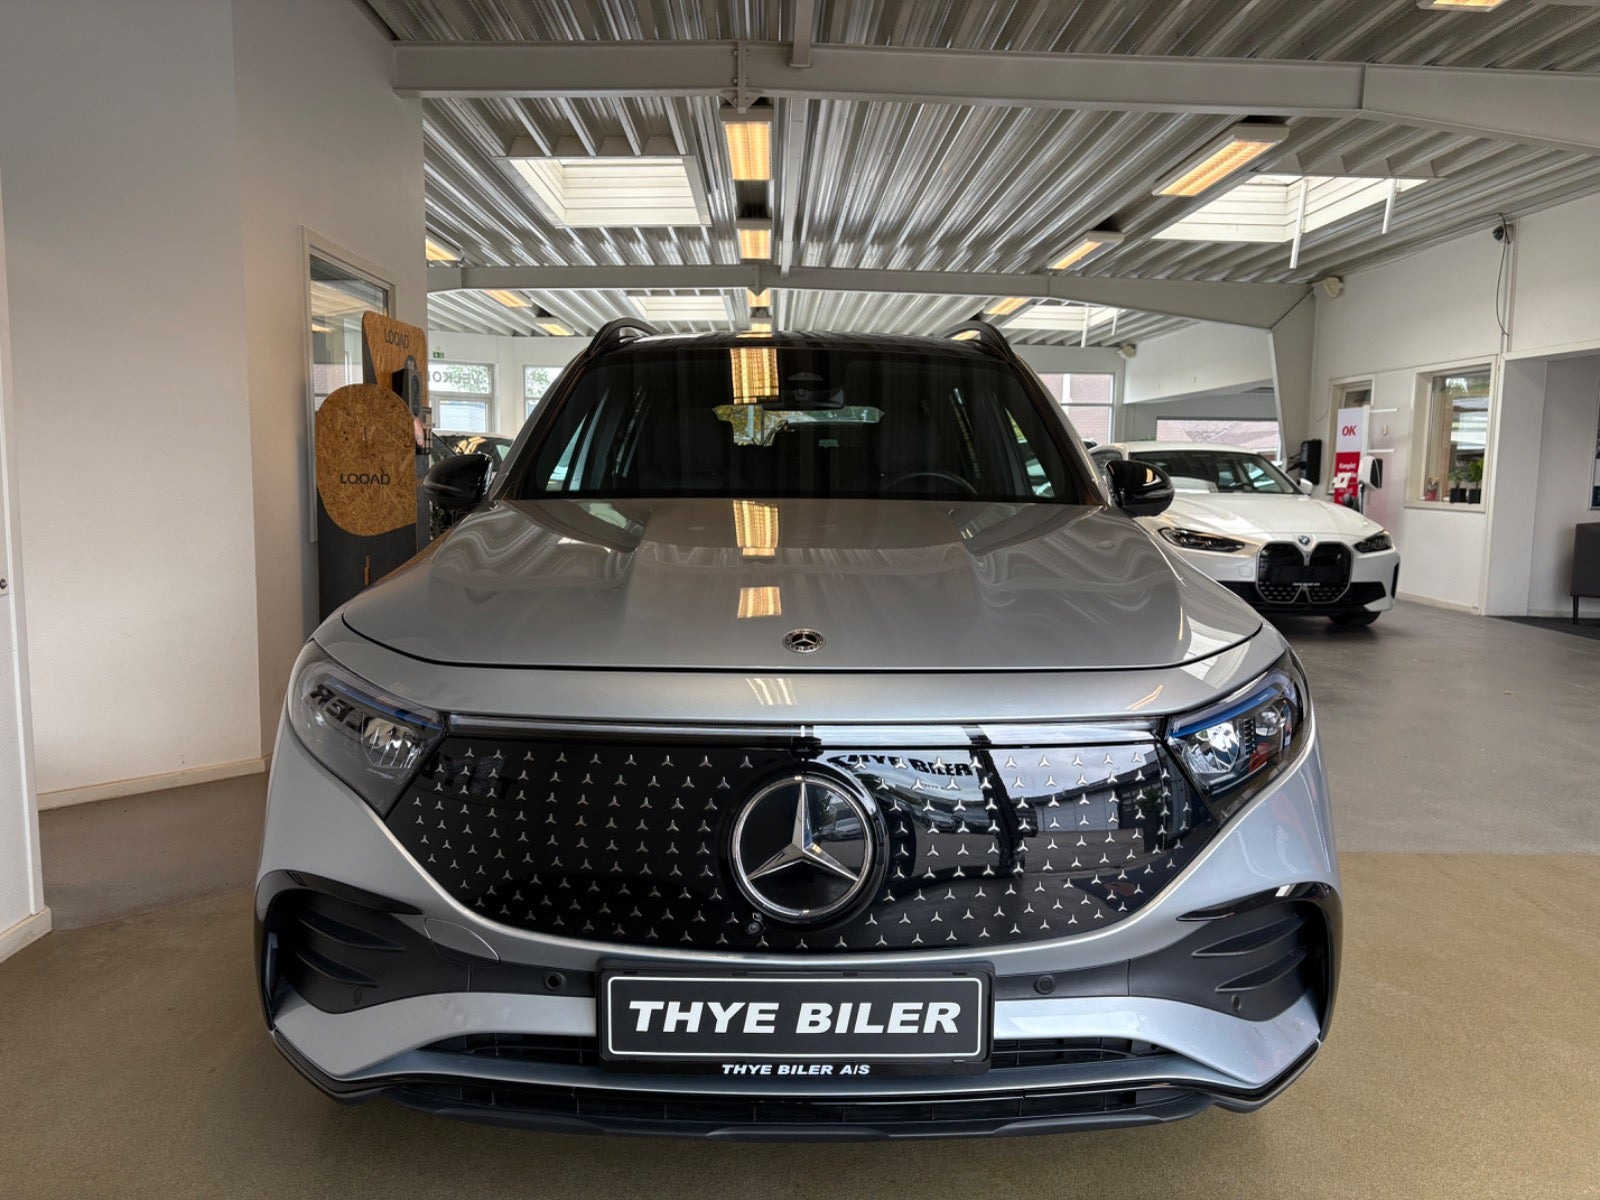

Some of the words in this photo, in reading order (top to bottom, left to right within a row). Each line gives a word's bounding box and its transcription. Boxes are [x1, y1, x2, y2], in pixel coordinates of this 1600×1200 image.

[1342, 425, 1357, 436] OK
[340, 473, 391, 485] LOOAD
[628, 1000, 780, 1034] THYE
[794, 1001, 962, 1035] BILER
[721, 1063, 773, 1076] THYE
[776, 1063, 833, 1077] BILER
[838, 1063, 871, 1077] A/S
